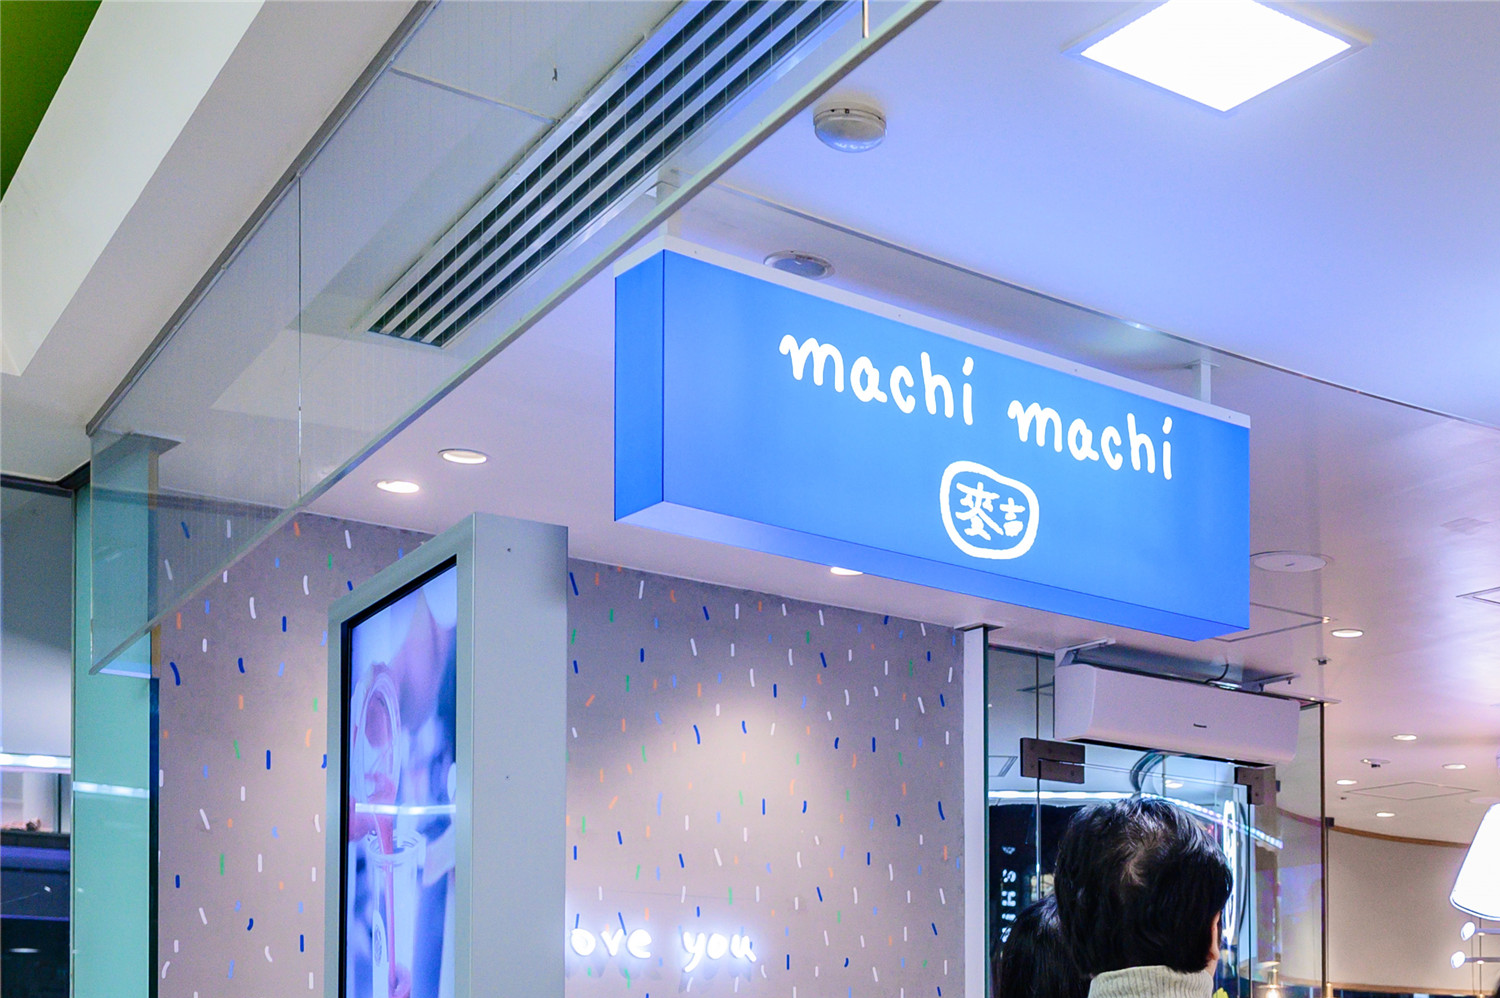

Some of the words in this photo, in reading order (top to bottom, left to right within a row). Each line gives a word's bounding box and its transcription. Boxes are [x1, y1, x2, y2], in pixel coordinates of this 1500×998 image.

[779, 334, 974, 425] machi
[1008, 400, 1173, 480] machi
[682, 931, 757, 973] you
